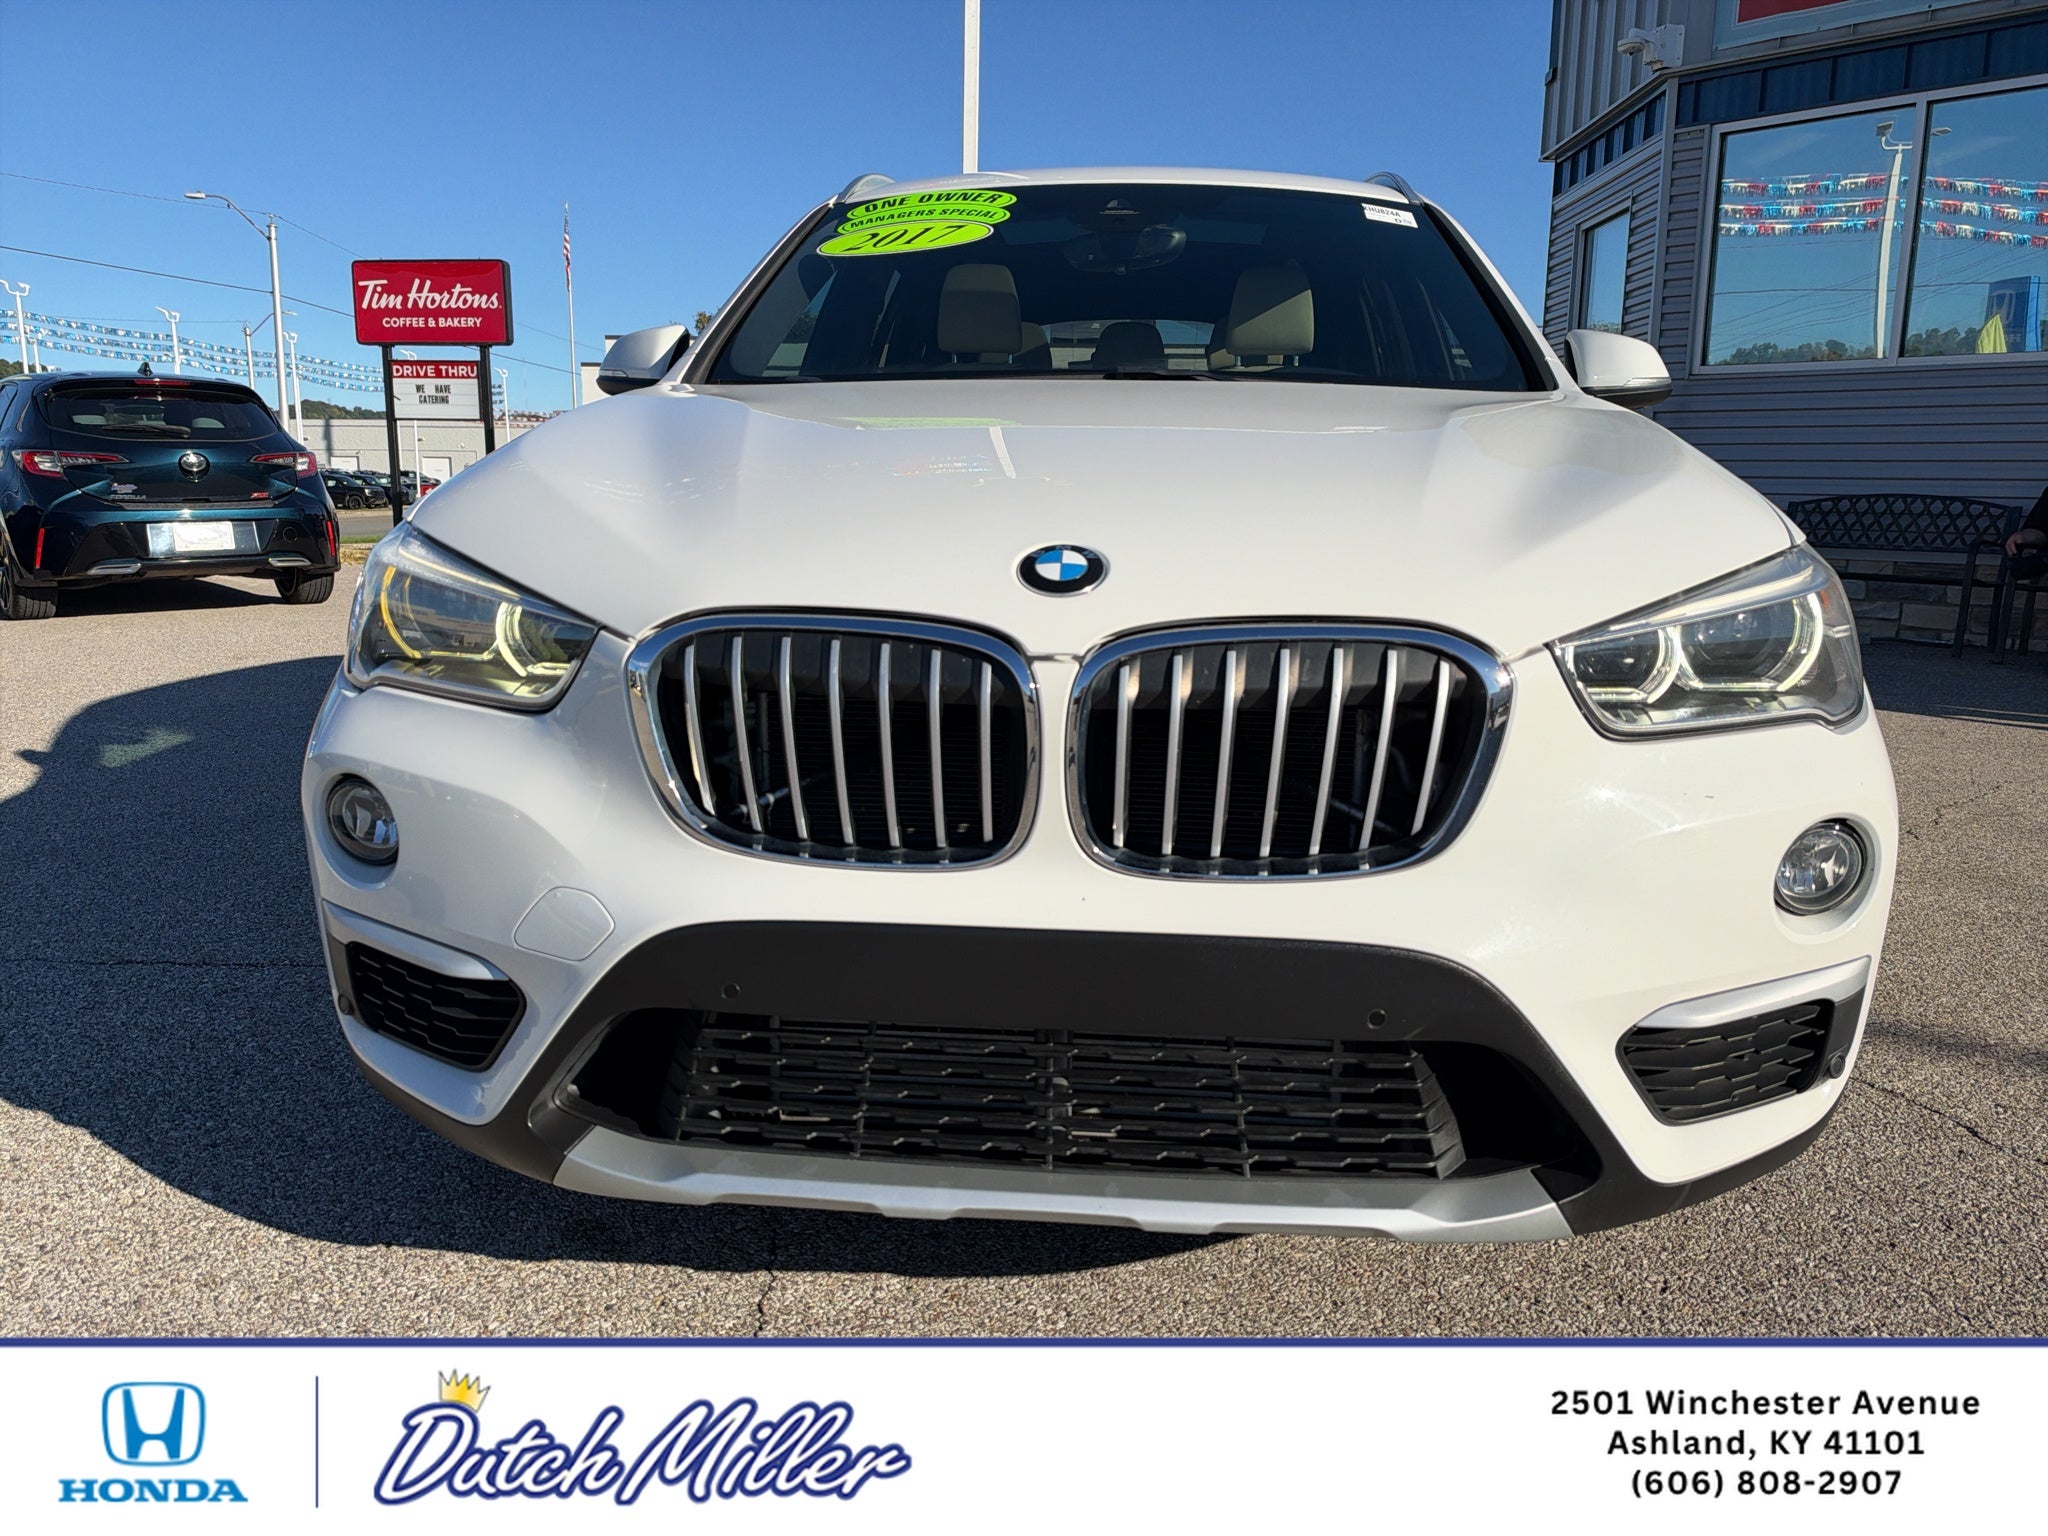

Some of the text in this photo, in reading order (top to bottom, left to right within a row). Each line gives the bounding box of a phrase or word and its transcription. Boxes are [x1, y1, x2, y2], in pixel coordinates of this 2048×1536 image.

[864, 192, 1002, 213] ONE OWNER
[851, 207, 998, 228] MANAGERS SPECIAL
[840, 224, 968, 252] 2017
[358, 279, 402, 310] Tim
[382, 317, 482, 328] COFFEE & BAKERY
[392, 365, 478, 378] DRIVE THRU
[415, 384, 452, 394] WE HAVE
[418, 395, 450, 405] CATERING
